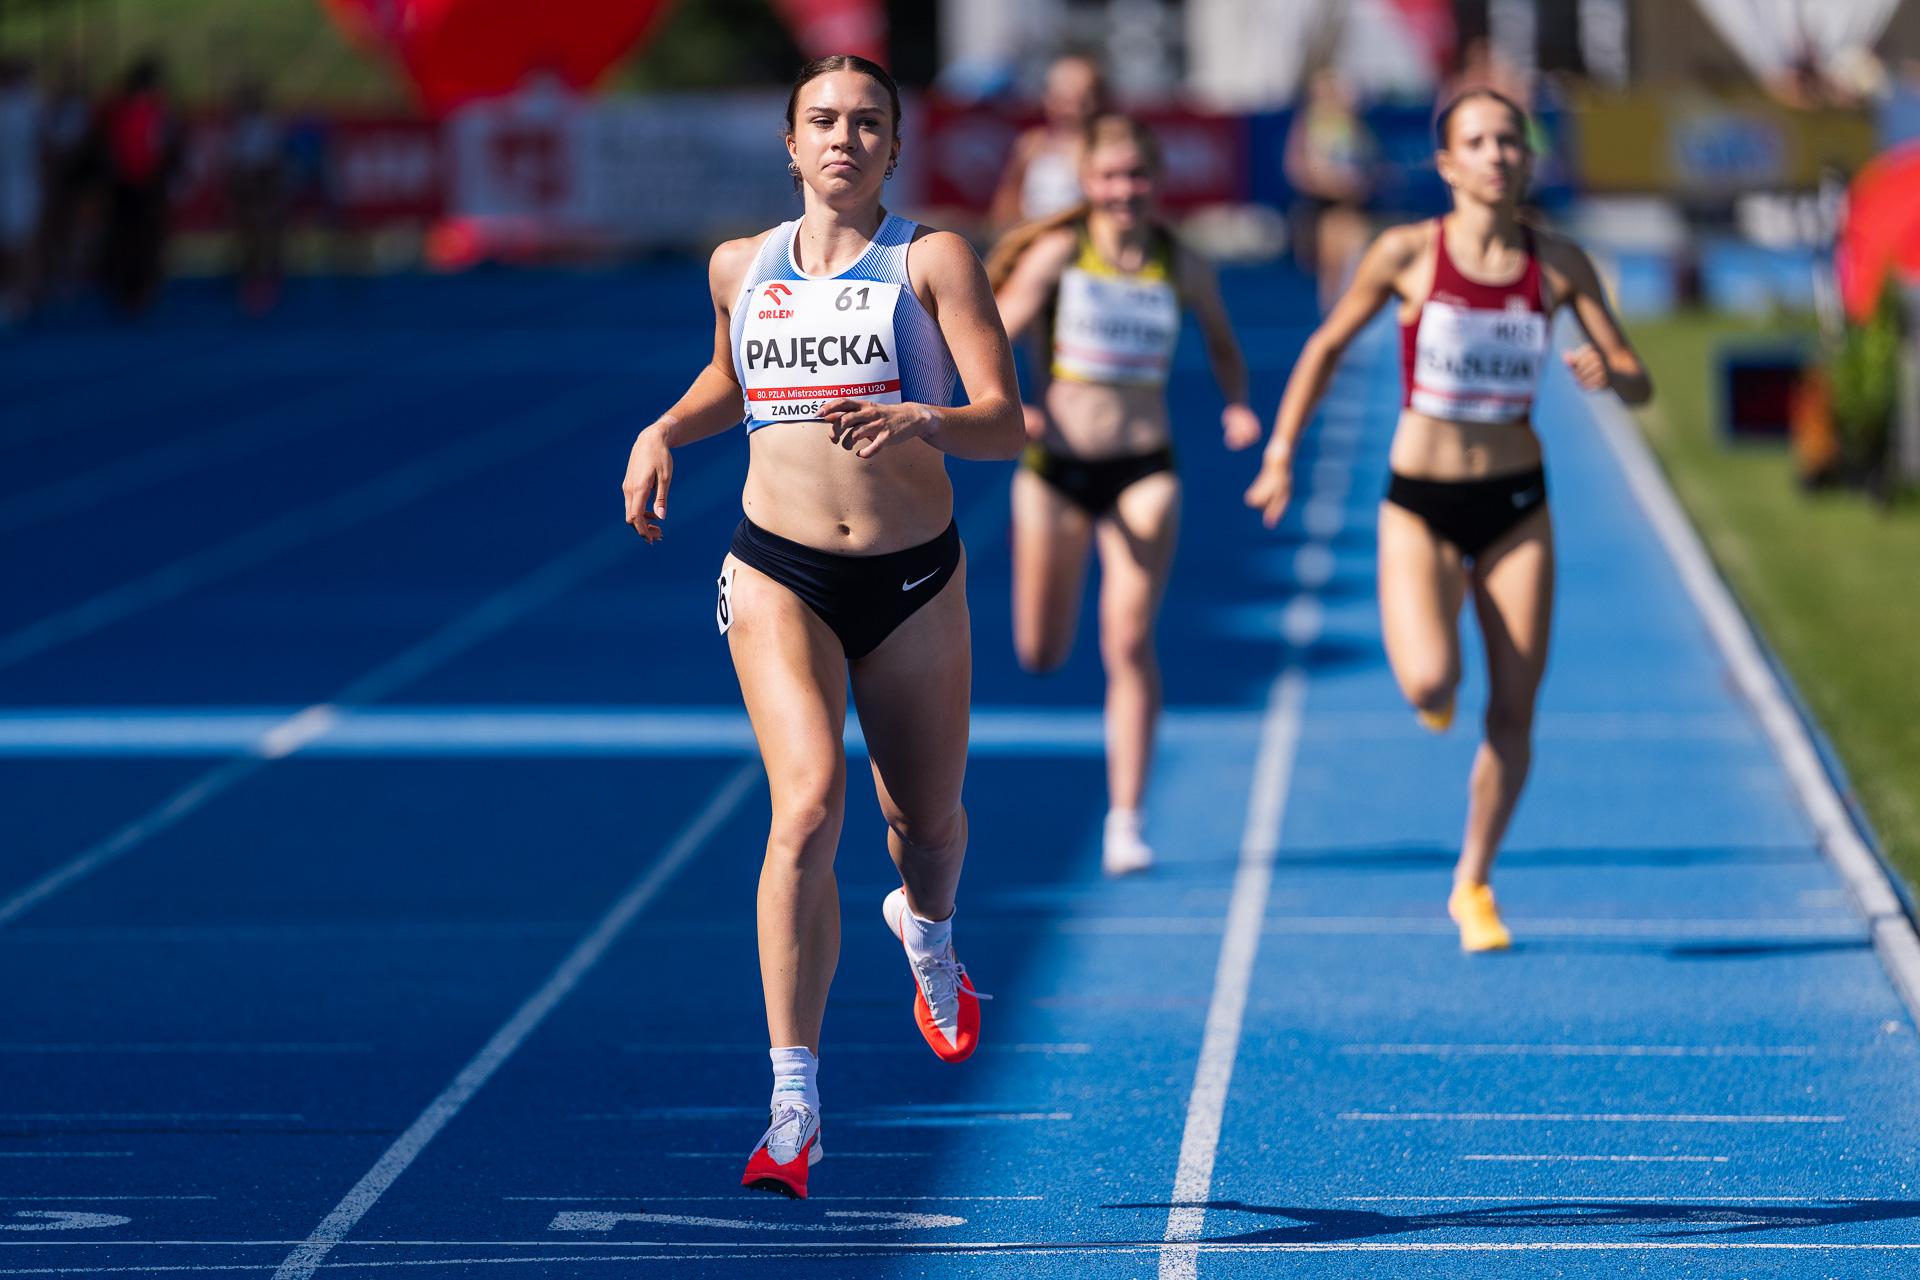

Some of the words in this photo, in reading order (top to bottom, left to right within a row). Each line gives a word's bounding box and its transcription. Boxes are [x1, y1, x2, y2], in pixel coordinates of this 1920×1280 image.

[835, 286, 870, 311] 61
[758, 309, 794, 320] ORLEN
[746, 334, 890, 374] PAJĘCKA
[757, 390, 768, 399] 80.
[768, 390, 786, 399] PZLA
[787, 388, 839, 398] Mistrzostwa
[840, 385, 866, 396] Polski
[868, 383, 886, 393] U20
[719, 576, 729, 626] 6
